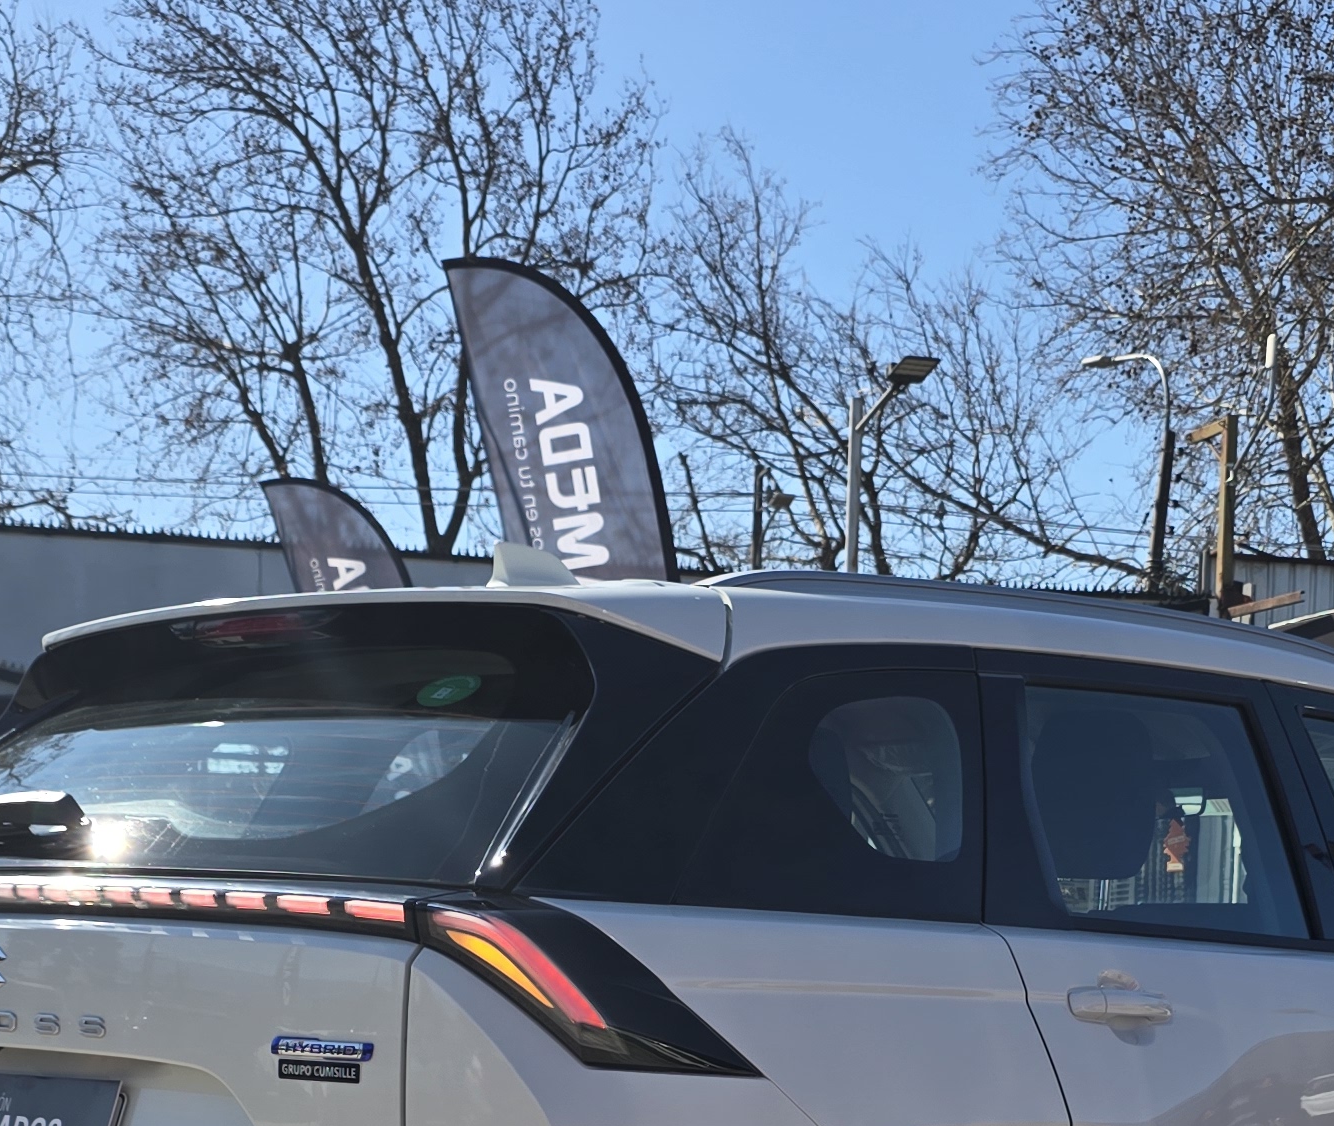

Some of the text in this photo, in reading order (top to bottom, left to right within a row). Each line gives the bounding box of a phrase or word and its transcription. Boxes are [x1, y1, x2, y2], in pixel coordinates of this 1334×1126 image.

[283, 1042, 357, 1056] HYBRID
[281, 1063, 357, 1079] GRUPO CUMSILLE
